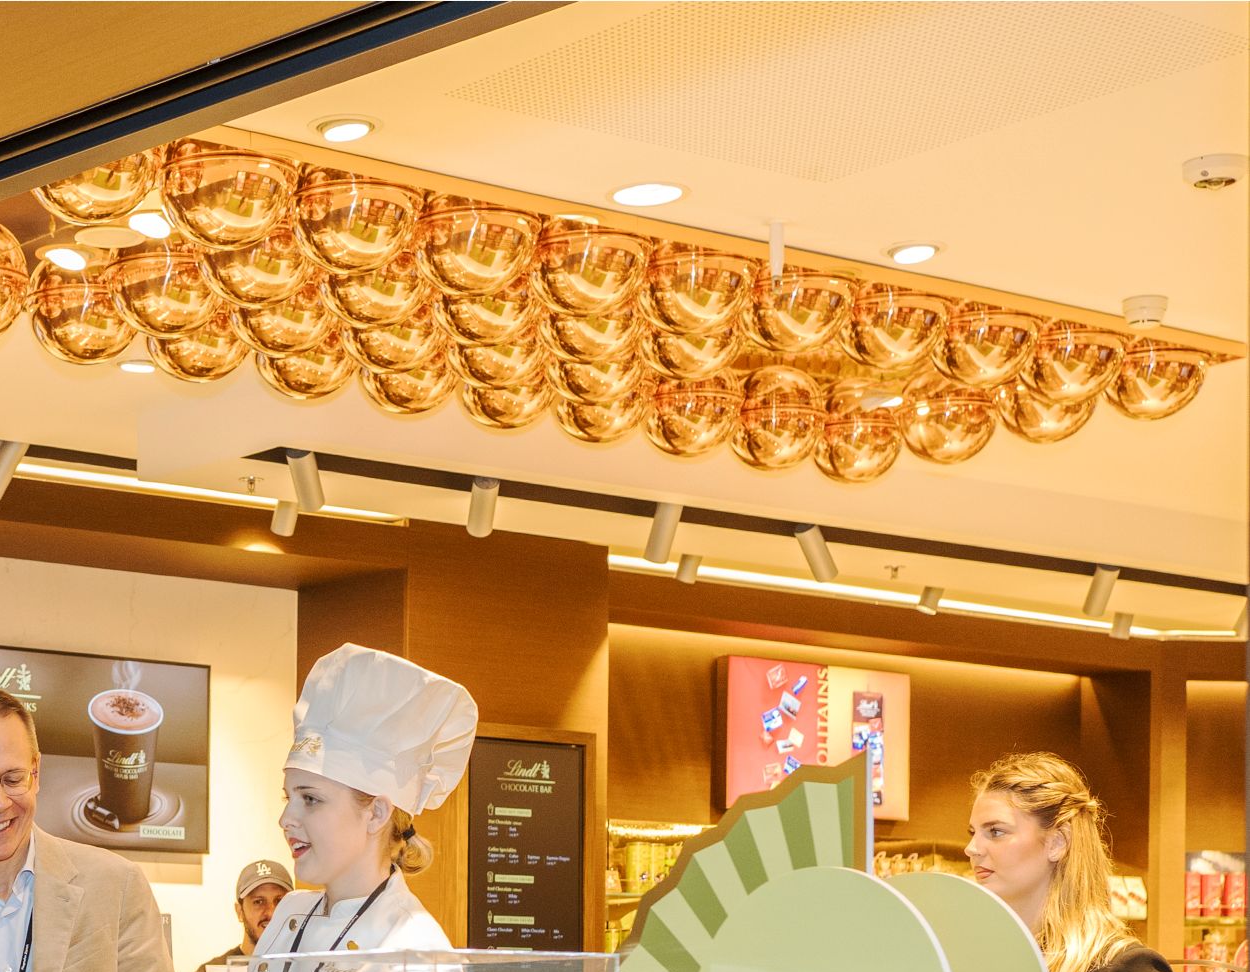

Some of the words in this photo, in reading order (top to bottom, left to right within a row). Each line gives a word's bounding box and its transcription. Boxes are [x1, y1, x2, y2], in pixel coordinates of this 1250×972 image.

[106, 750, 139, 765] Lindt
[503, 759, 541, 778] Lindt
[500, 782, 539, 793] CHOCOLATE
[540, 784, 553, 794] BAR
[142, 827, 184, 837] CHOCOLATE
[255, 862, 271, 876] LA
